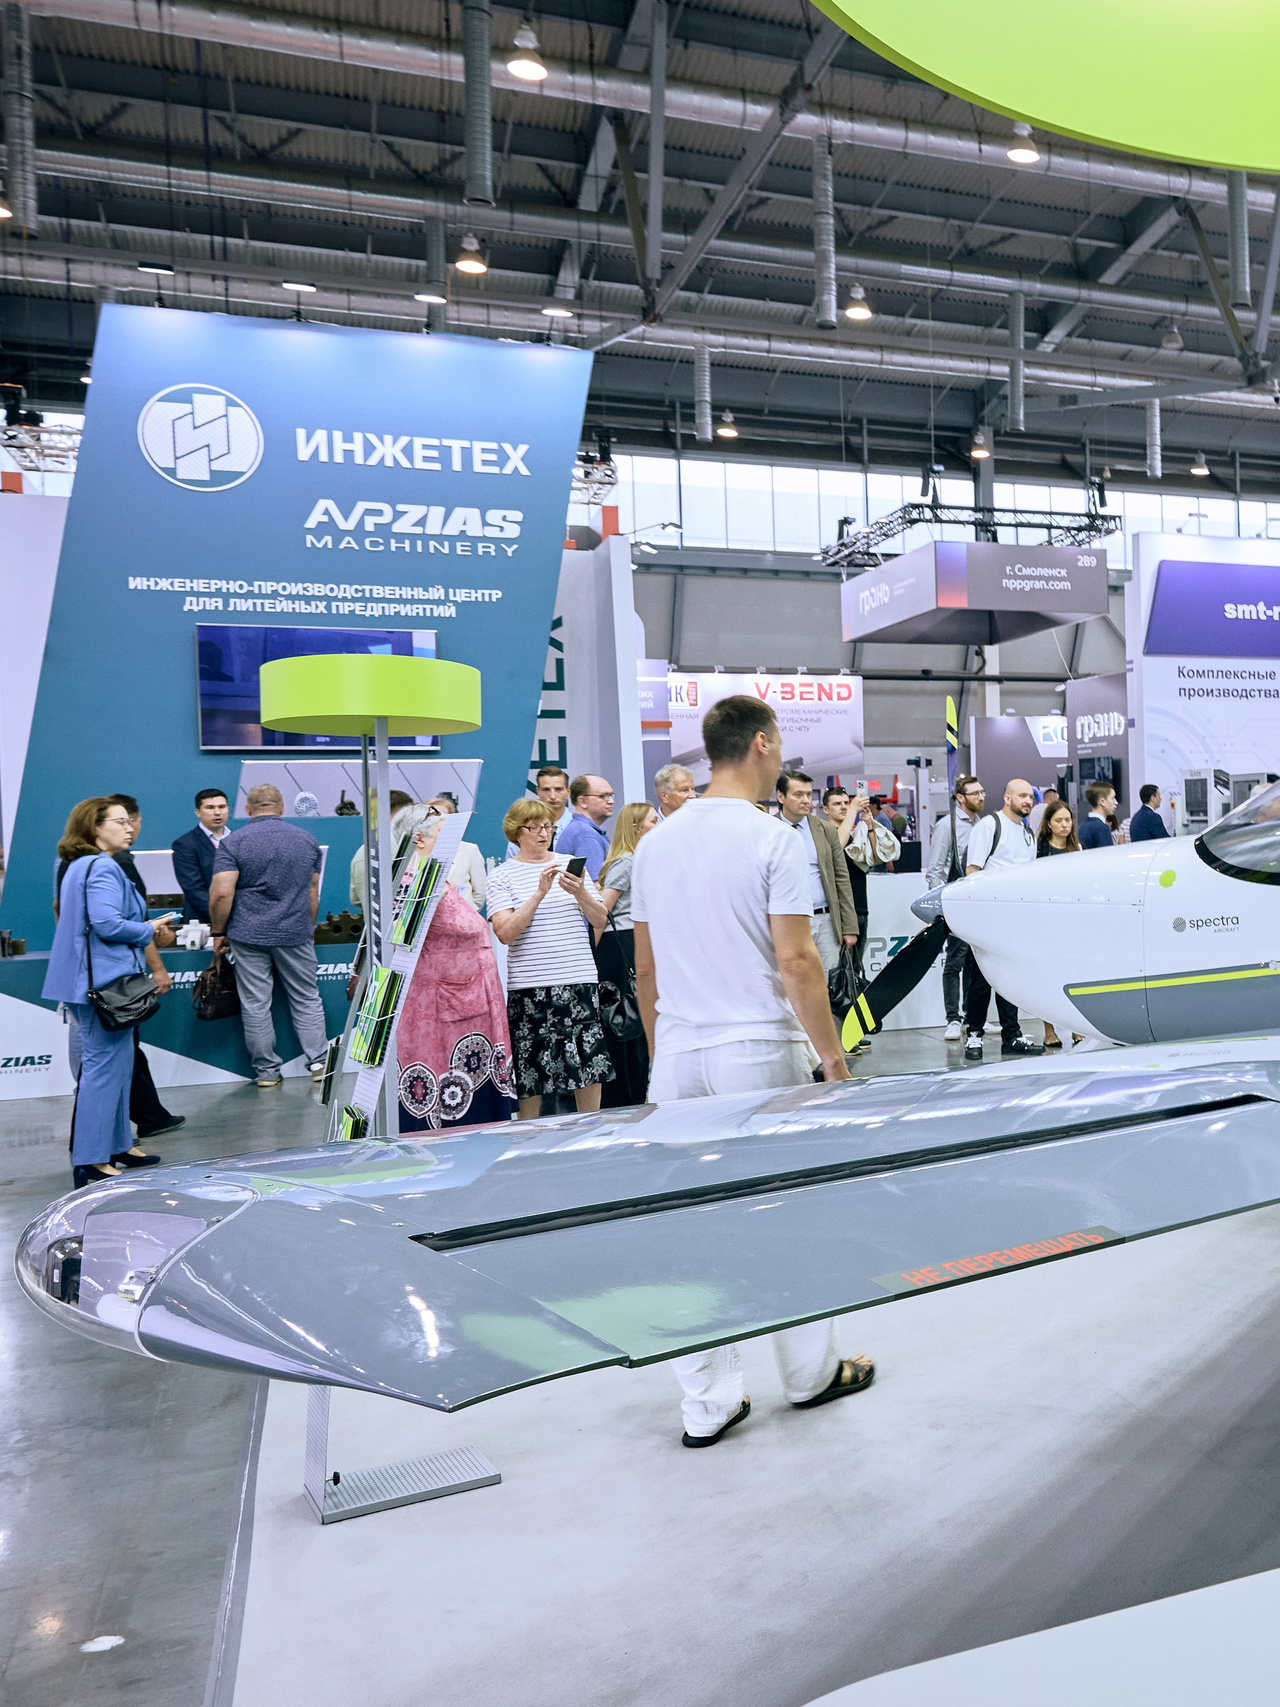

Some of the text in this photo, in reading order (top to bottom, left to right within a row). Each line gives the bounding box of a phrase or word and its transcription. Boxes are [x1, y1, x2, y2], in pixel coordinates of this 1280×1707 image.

[296, 428, 531, 476] ИНЖЕТЕХ
[305, 534, 519, 557] MACHINERY
[1015, 564, 1068, 578] Смоленск
[128, 576, 503, 602] ИНЖЕНЕРНО-ПРОИЗВОДСТВЕННЫЙ ЦЕНТР
[1002, 577, 1071, 592] nppgran.com
[183, 596, 457, 618] ДЛЯ ЛИТЕЙНЫХ ПРЕДПРИЯТИЙ
[1177, 665, 1277, 681] Комплексные
[754, 682, 853, 701] V-BEND
[1178, 687, 1280, 701] производства
[1189, 915, 1240, 931] spectra
[901, 1231, 1105, 1288] НЕ ПЕРЕМЕЩАТЬ
